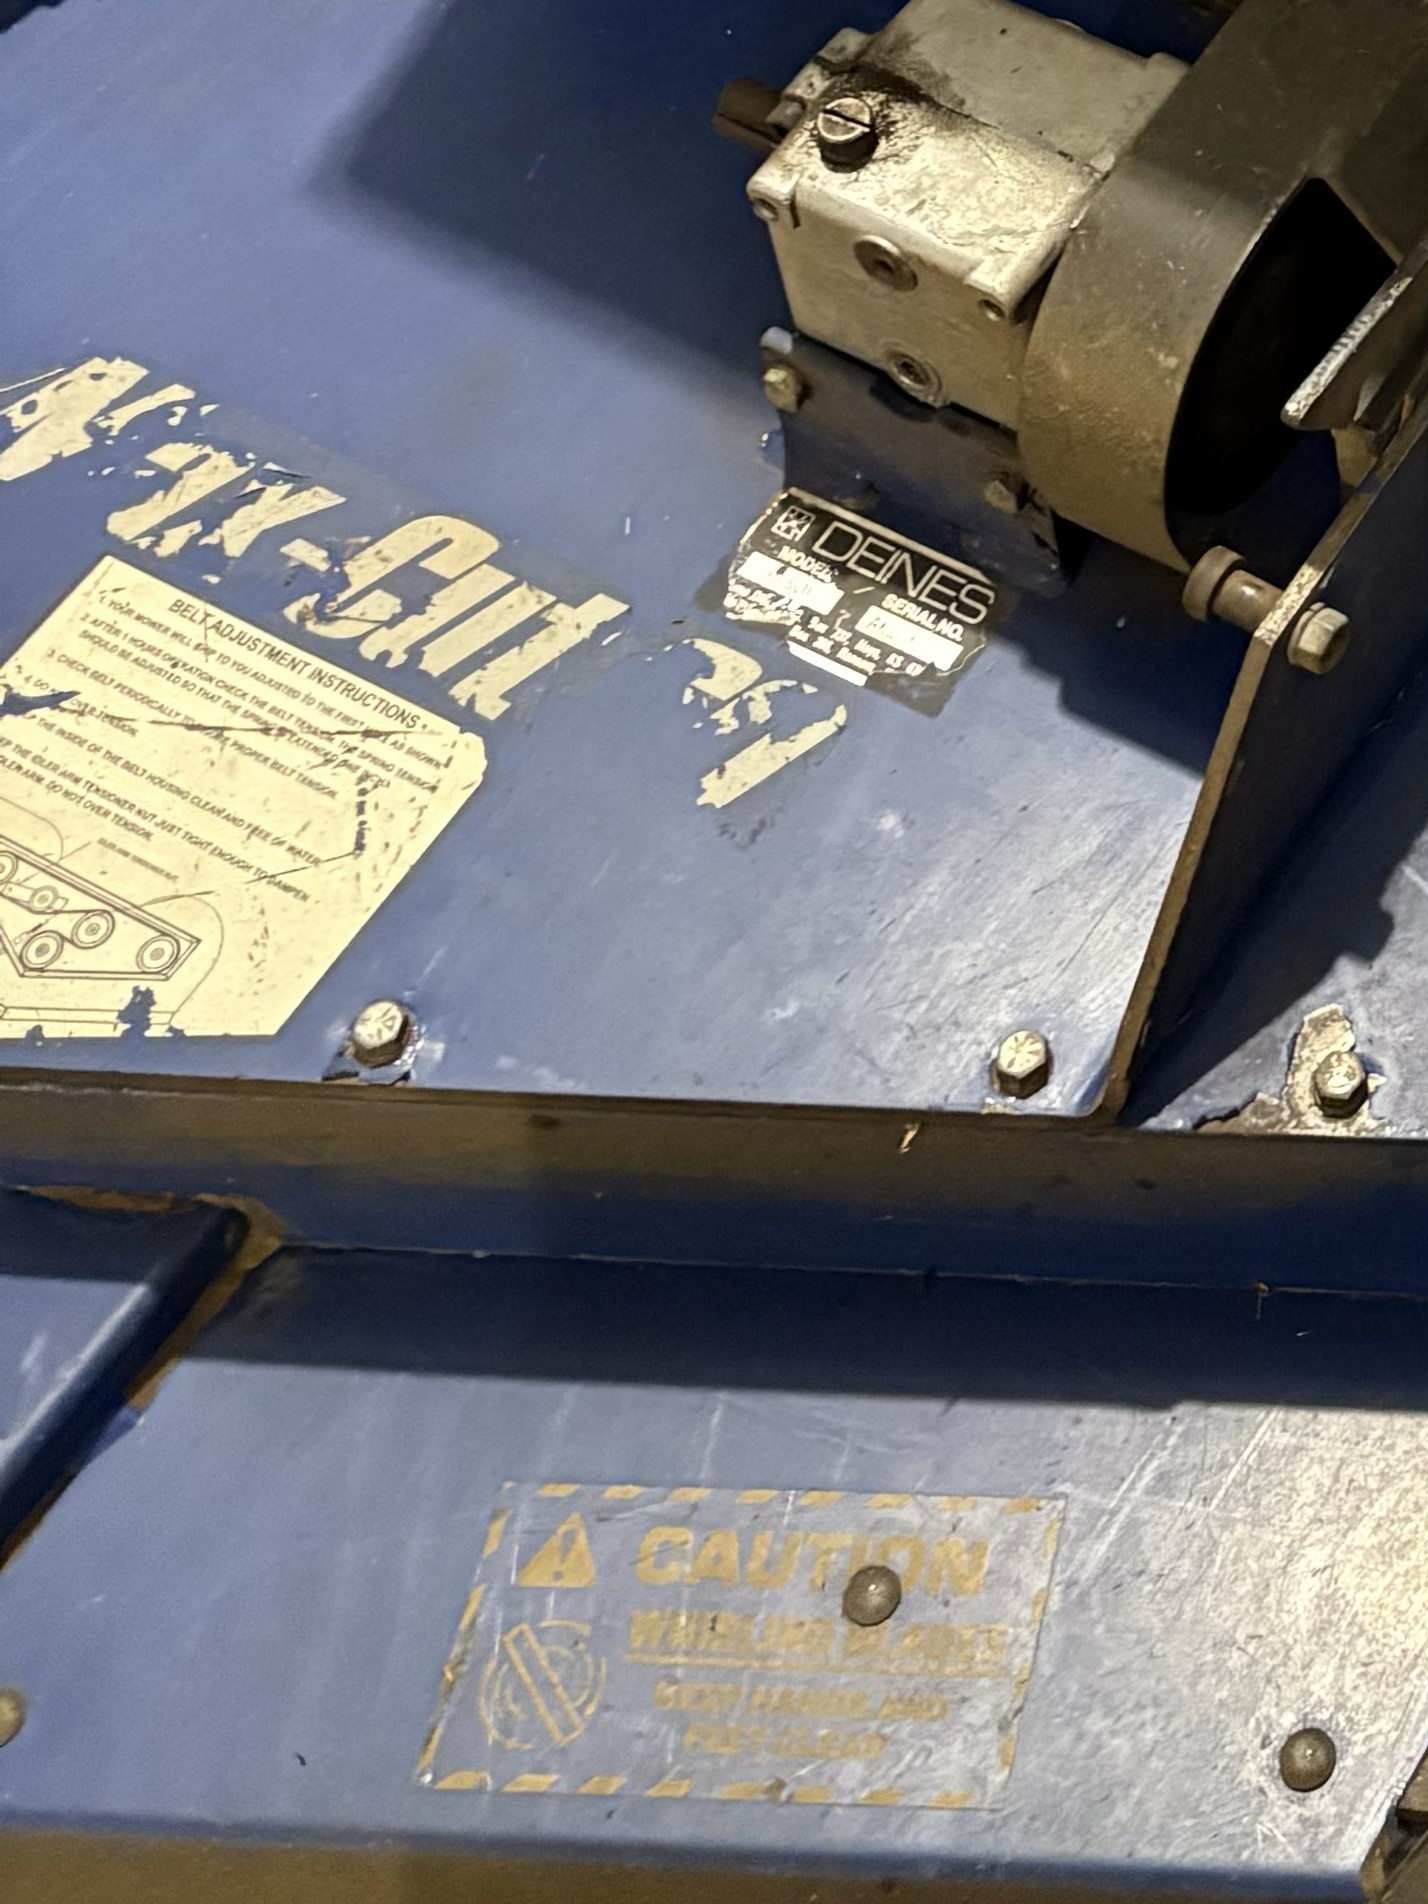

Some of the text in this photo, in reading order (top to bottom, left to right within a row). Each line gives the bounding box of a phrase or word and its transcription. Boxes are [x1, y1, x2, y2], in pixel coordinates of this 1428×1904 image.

[812, 521, 996, 626] DEINES
[880, 593, 941, 633] SERIAL
[935, 620, 964, 643] NO.
[56, 653, 91, 675] CHECK
[88, 669, 114, 686] BELT
[112, 681, 181, 720] PERIODICALLY
[228, 740, 271, 765] PROPER
[268, 759, 296, 777] BELT
[78, 629, 119, 653] SHOULD
[117, 648, 132, 659] BE
[130, 655, 182, 684] ADJUSTED
[179, 679, 197, 691] SO
[195, 687, 222, 704] THAT
[220, 699, 241, 714] THE
[88, 617, 122, 637] AFTER
[126, 636, 162, 657] HOURS
[214, 679, 249, 700] CHECK
[248, 695, 269, 709] THE
[266, 704, 294, 722] BELT
[357, 749, 395, 772] SPRING
[107, 600, 135, 617] YOUR
[132, 612, 171, 635] MOWER
[169, 630, 193, 646] WILL
[215, 653, 231, 664] TO
[229, 660, 252, 675] YOU
[249, 669, 302, 699] ADJUSTED
[300, 694, 316, 706] TO
[315, 702, 337, 716] THE
[334, 711, 364, 730] FIRST
[167, 598, 421, 729] BELT ADJUSTMENT INSTRUCTIONS
[11, 744, 33, 759] THE
[30, 753, 61, 773] IDLER
[58, 767, 84, 784] ARM
[81, 781, 137, 812] TENSIONER
[134, 807, 158, 823] NUT
[153, 817, 183, 836] JUST
[180, 830, 213, 851] TIGHT
[209, 845, 255, 872] ENOUGH
[35, 717, 56, 731] THE
[54, 726, 88, 747] INSIDE
[86, 742, 103, 755] OF
[101, 750, 123, 765] THE
[120, 759, 147, 777] BELT
[144, 772, 191, 800] HOUSING
[188, 794, 225, 817] CLEAN
[221, 811, 245, 827] AND
[44, 780, 63, 793] DO
[60, 788, 84, 804] NOT
[82, 799, 111, 818] OVER
[634, 1525, 991, 1597] CAUTION
